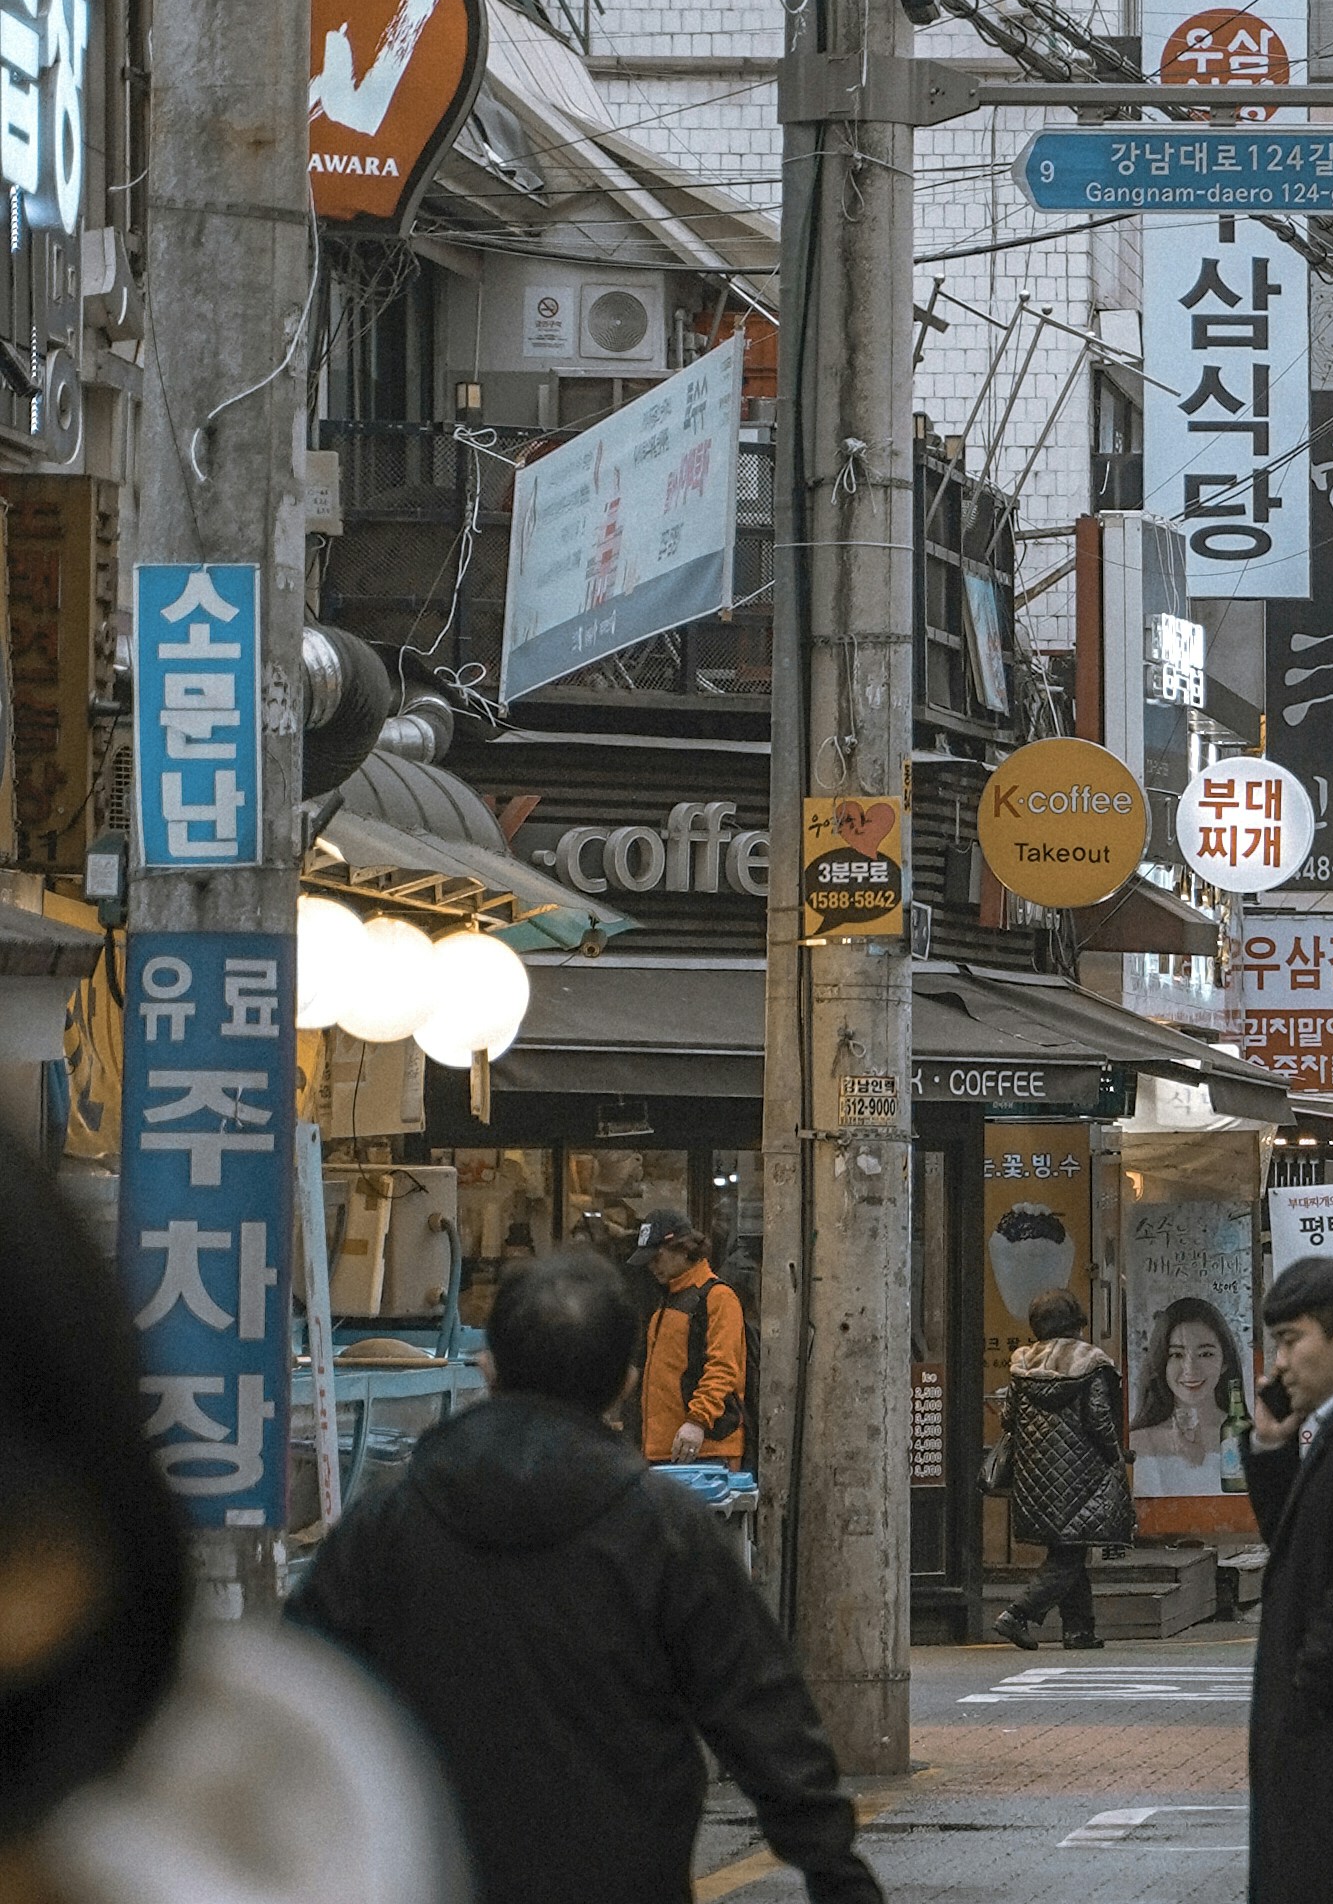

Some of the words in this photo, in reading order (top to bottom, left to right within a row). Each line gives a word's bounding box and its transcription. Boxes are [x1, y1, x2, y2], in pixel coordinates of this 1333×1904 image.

[1040, 162, 1055, 185] 9
[1086, 182, 1272, 206] Gangnam-daero
[159, 570, 244, 859] 소문난
[1198, 779, 1283, 821] 부대
[1015, 841, 1111, 865] Takeout
[1197, 826, 1283, 867] 찌개
[818, 861, 889, 884] 3분무료
[950, 1069, 1045, 1096] COFFEE
[134, 1069, 278, 1497] 주차장
